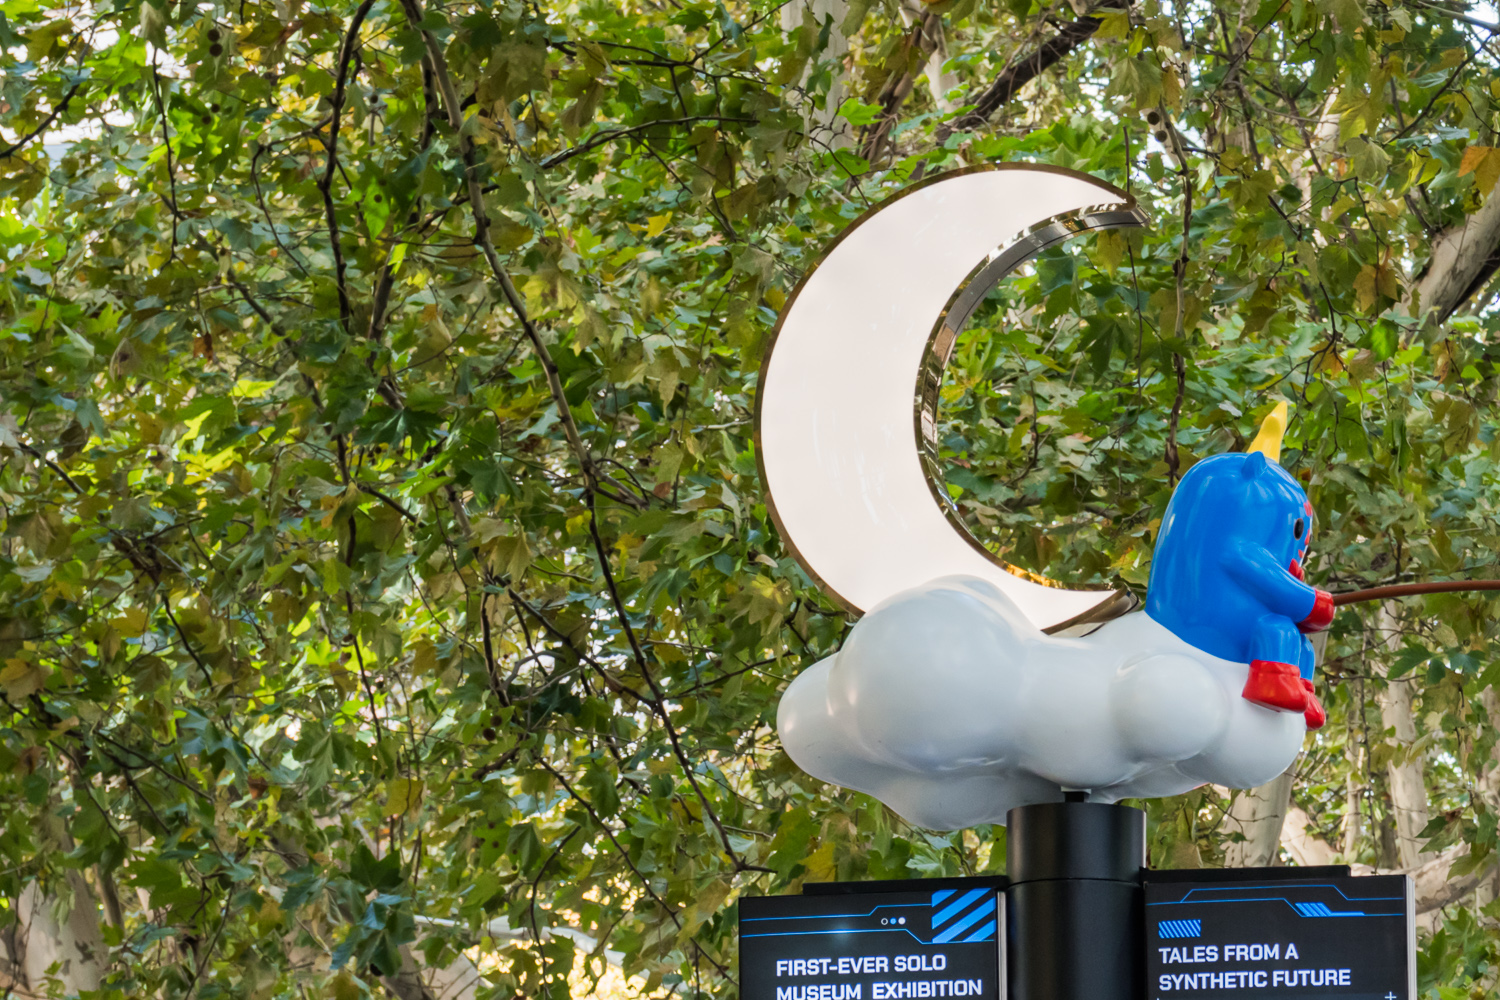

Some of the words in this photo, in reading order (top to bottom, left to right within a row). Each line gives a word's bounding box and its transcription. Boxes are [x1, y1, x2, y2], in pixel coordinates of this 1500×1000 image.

[1159, 946, 1218, 963] TALES
[1224, 944, 1279, 961] FROM
[1285, 943, 1299, 959] A
[776, 956, 889, 976] FIRST-EVER
[894, 954, 946, 971] SOLO
[872, 979, 982, 1000] EXHIBITION
[1159, 971, 1267, 990] SYNTHETIC
[1273, 969, 1351, 987] FUTURE
